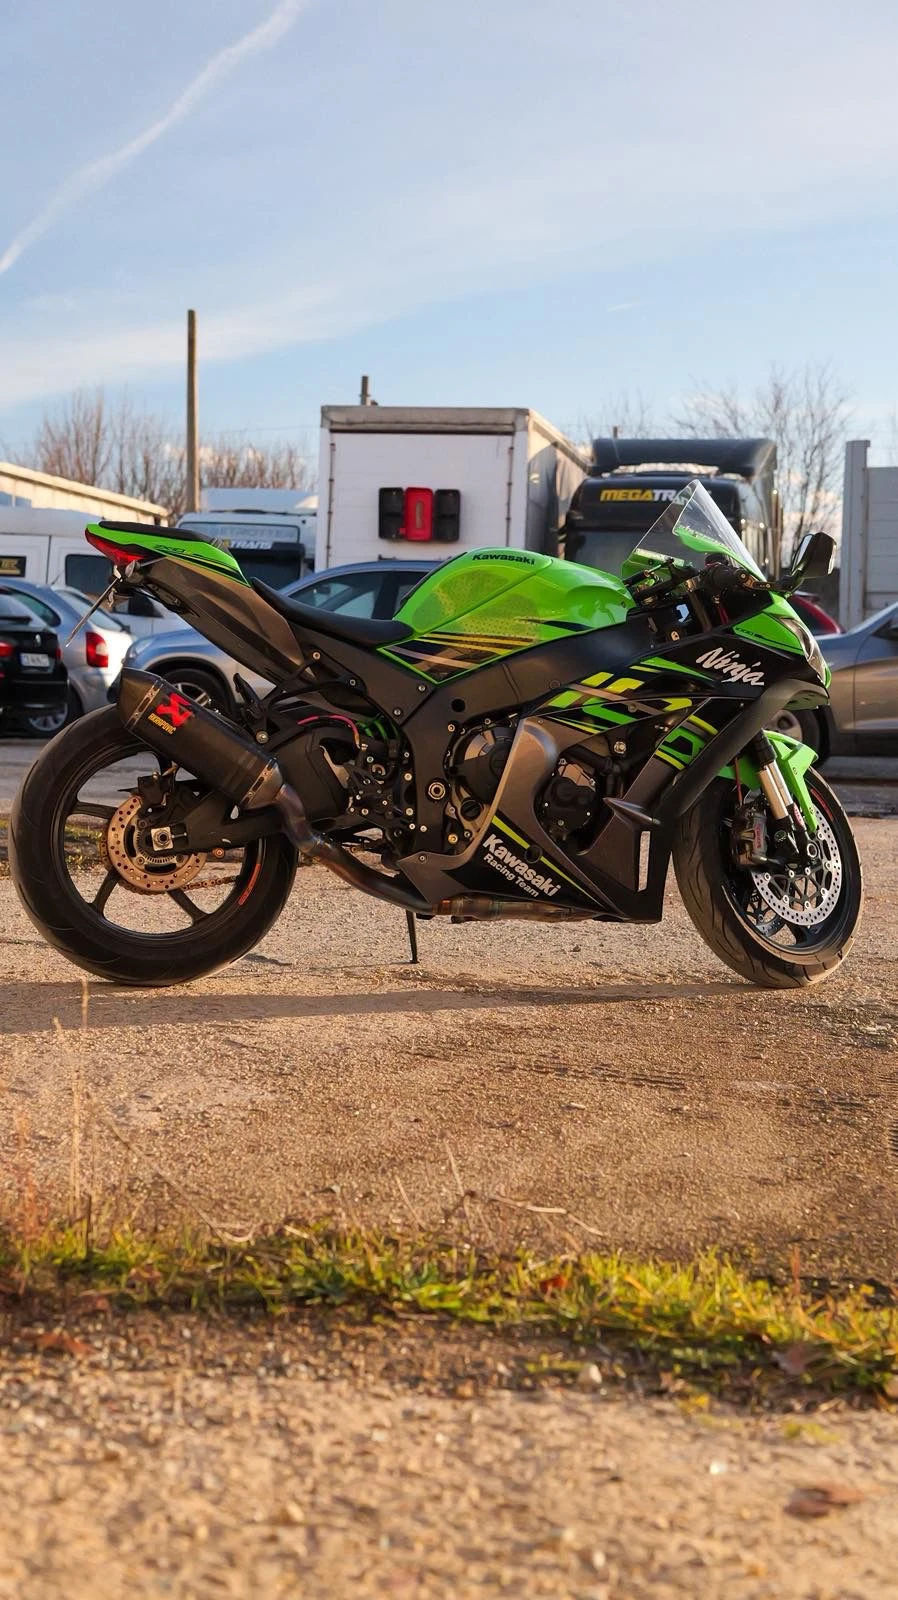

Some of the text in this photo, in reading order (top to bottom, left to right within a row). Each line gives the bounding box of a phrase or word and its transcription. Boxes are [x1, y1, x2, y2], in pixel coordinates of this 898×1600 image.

[472, 554, 536, 565] Kawasaki
[695, 647, 765, 686] Ninja
[482, 833, 561, 897] Kawasaki
[483, 853, 540, 898] Racing Team
